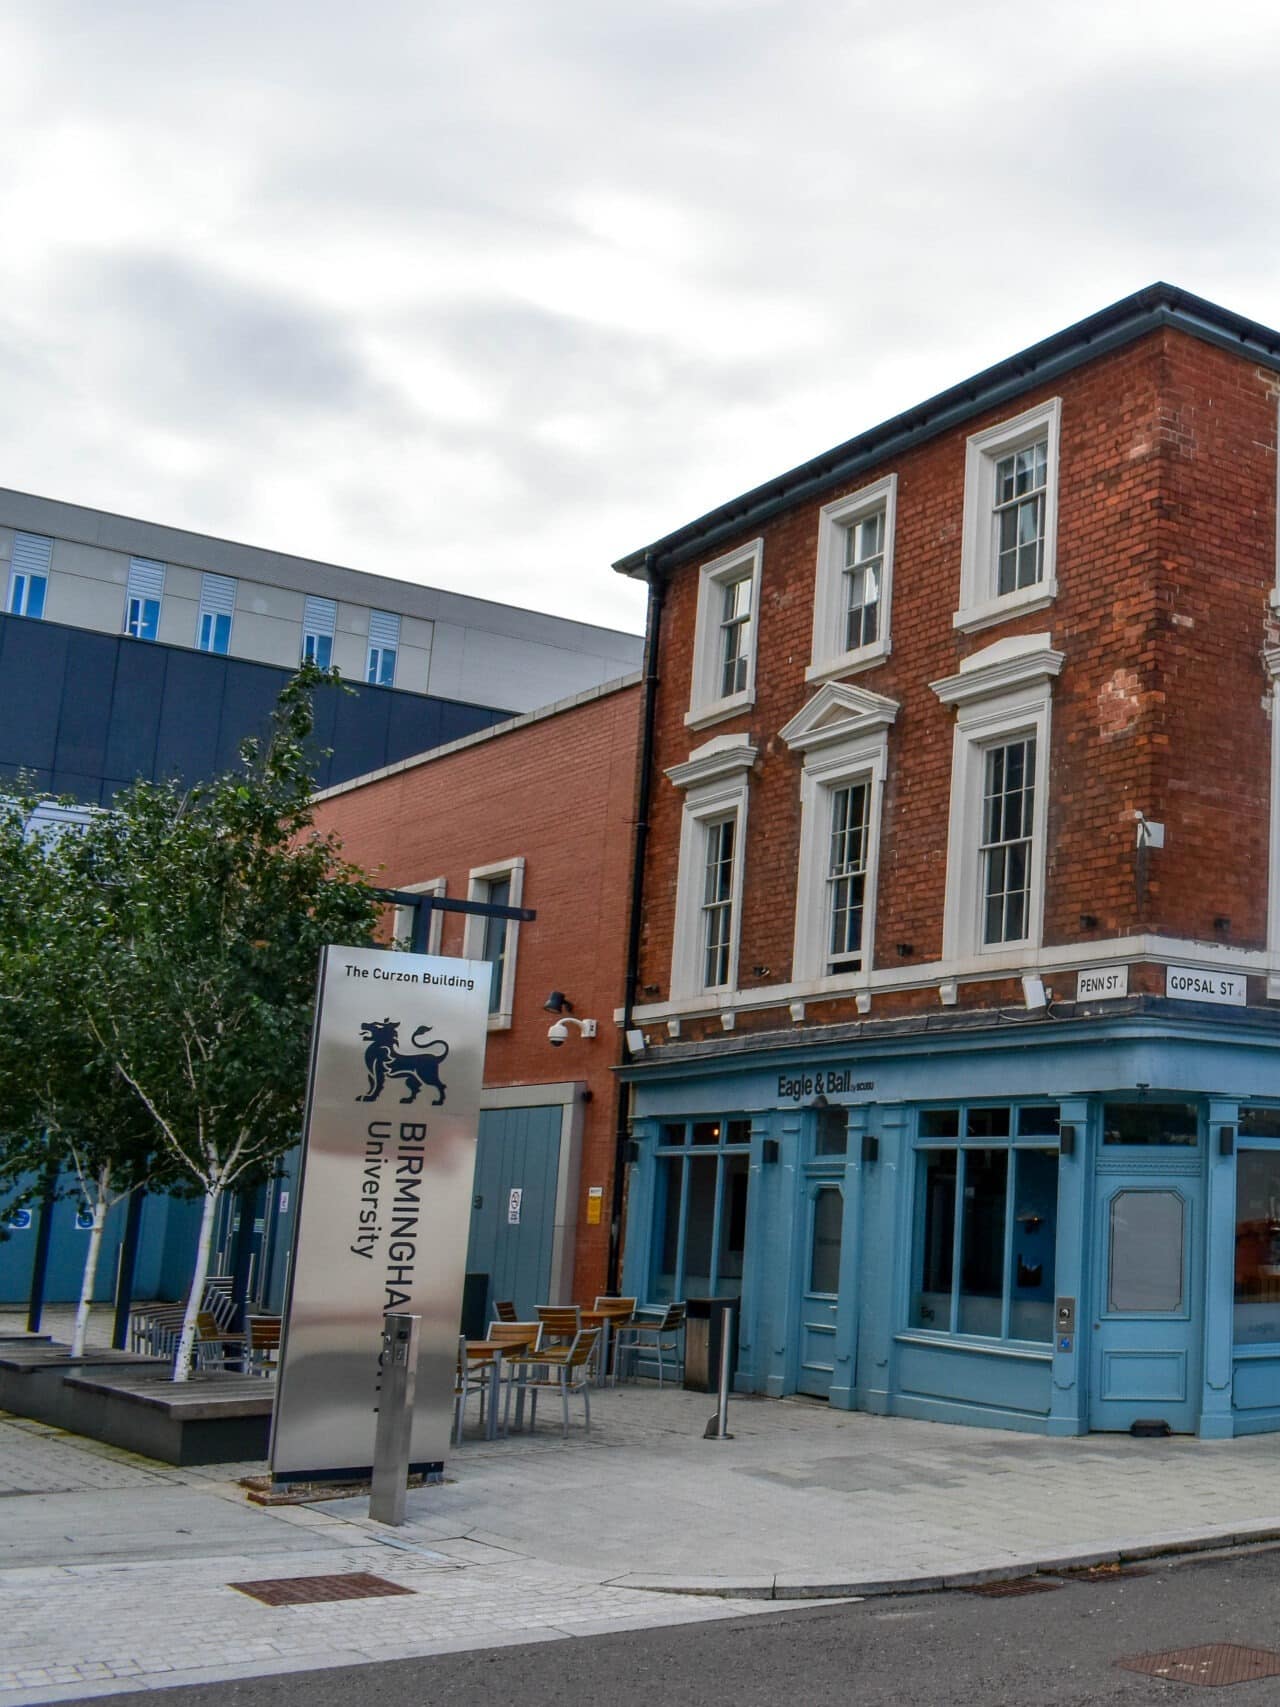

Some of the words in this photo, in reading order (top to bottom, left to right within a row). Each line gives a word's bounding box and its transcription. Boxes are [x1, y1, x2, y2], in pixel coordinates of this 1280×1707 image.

[345, 965, 369, 978] The
[373, 968, 419, 983] Curzon
[423, 973, 474, 991] Building
[1080, 977, 1105, 992] PENN
[1106, 976, 1119, 989] ST
[1171, 976, 1215, 994] GOPSAL
[1220, 982, 1234, 996] ST
[778, 1073, 813, 1101] Eagle
[815, 1072, 825, 1095] &
[826, 1070, 851, 1094] Ball
[350, 1121, 392, 1259] University
[383, 1122, 427, 1316] BIRMINGHA
